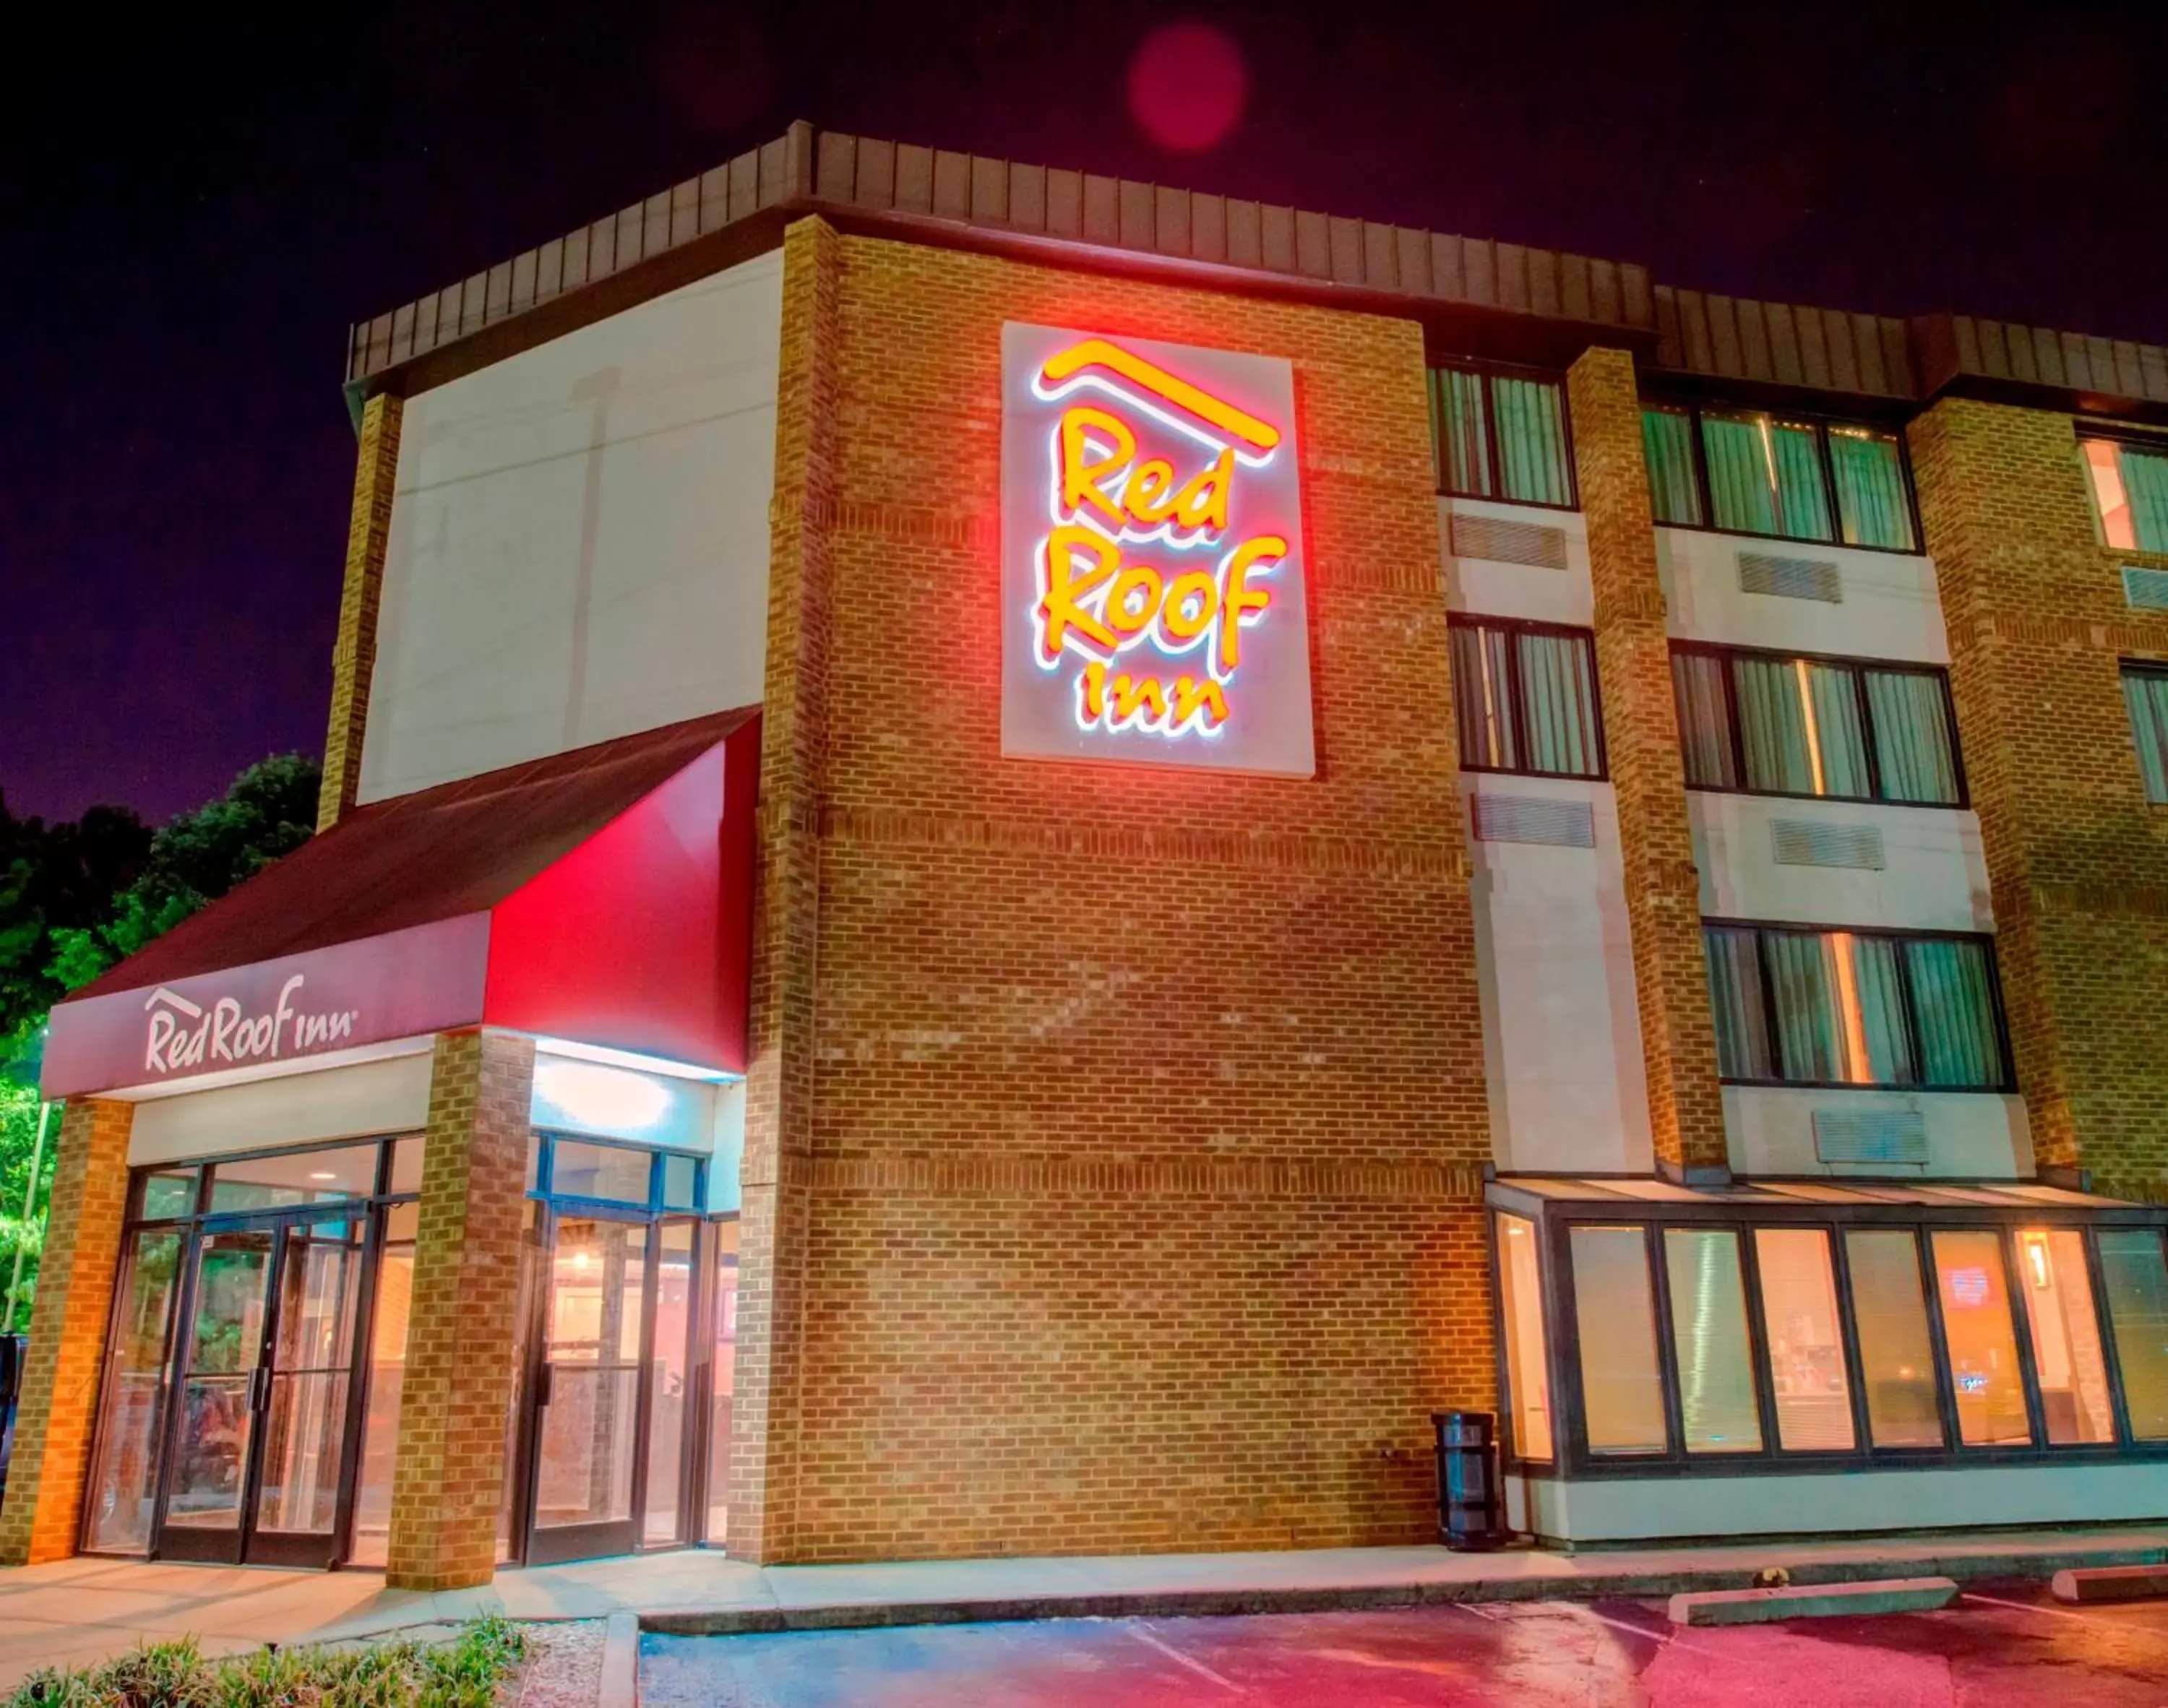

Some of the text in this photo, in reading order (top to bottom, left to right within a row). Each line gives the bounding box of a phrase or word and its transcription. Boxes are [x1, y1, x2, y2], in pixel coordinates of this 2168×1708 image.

[1057, 406, 1236, 536] Red
[1038, 525, 1288, 672] Roof
[145, 1010, 212, 1074] Red
[211, 974, 305, 1062] Roof
